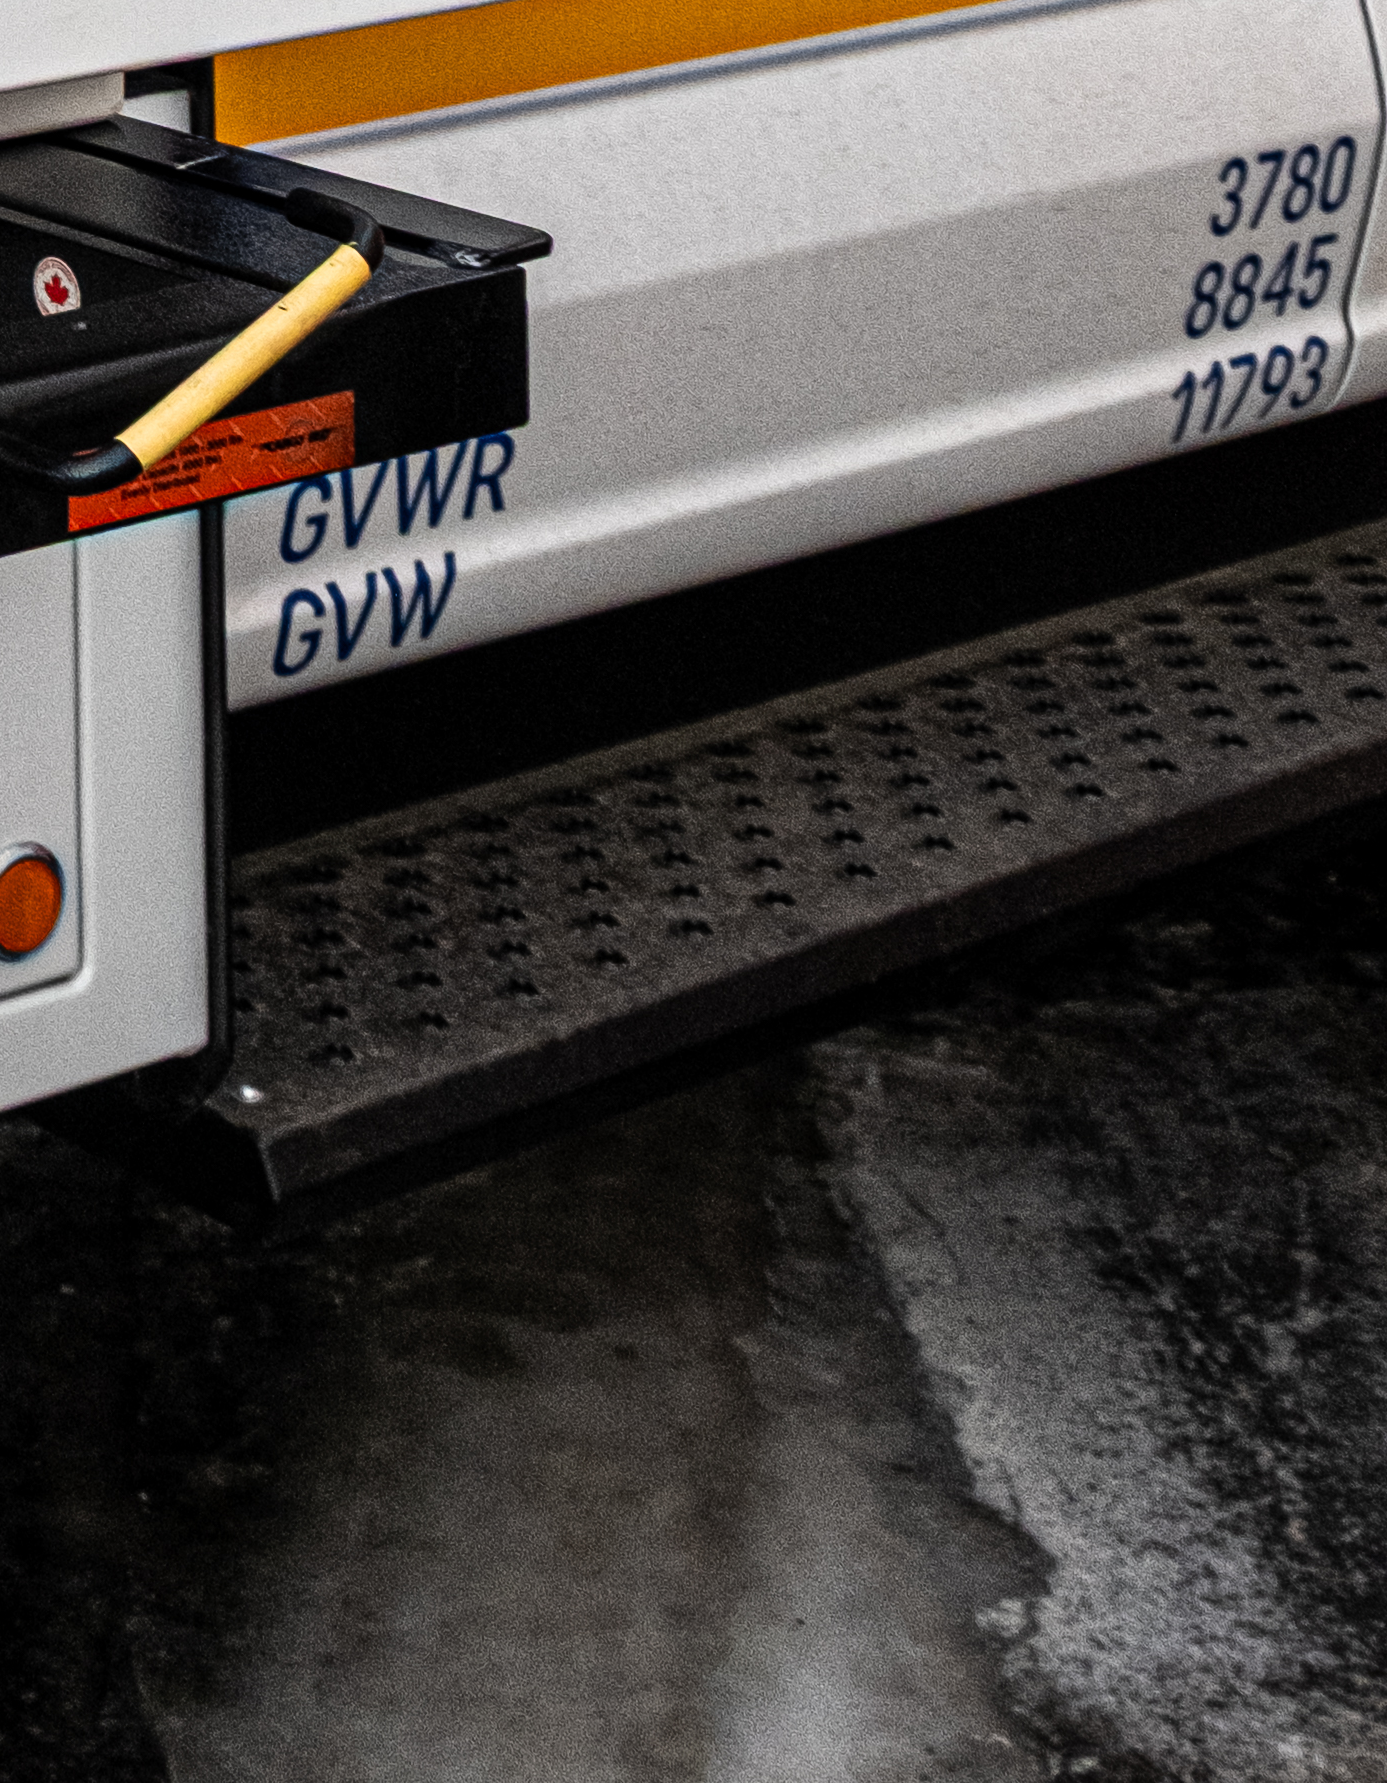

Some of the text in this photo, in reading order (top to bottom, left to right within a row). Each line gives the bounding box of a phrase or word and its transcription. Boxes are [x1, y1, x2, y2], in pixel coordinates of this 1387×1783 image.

[1209, 135, 1357, 237] 3780
[1184, 233, 1338, 339] 8845
[1173, 335, 1328, 444] 11793
[280, 432, 515, 564] GVWR
[273, 550, 457, 676] GVW
